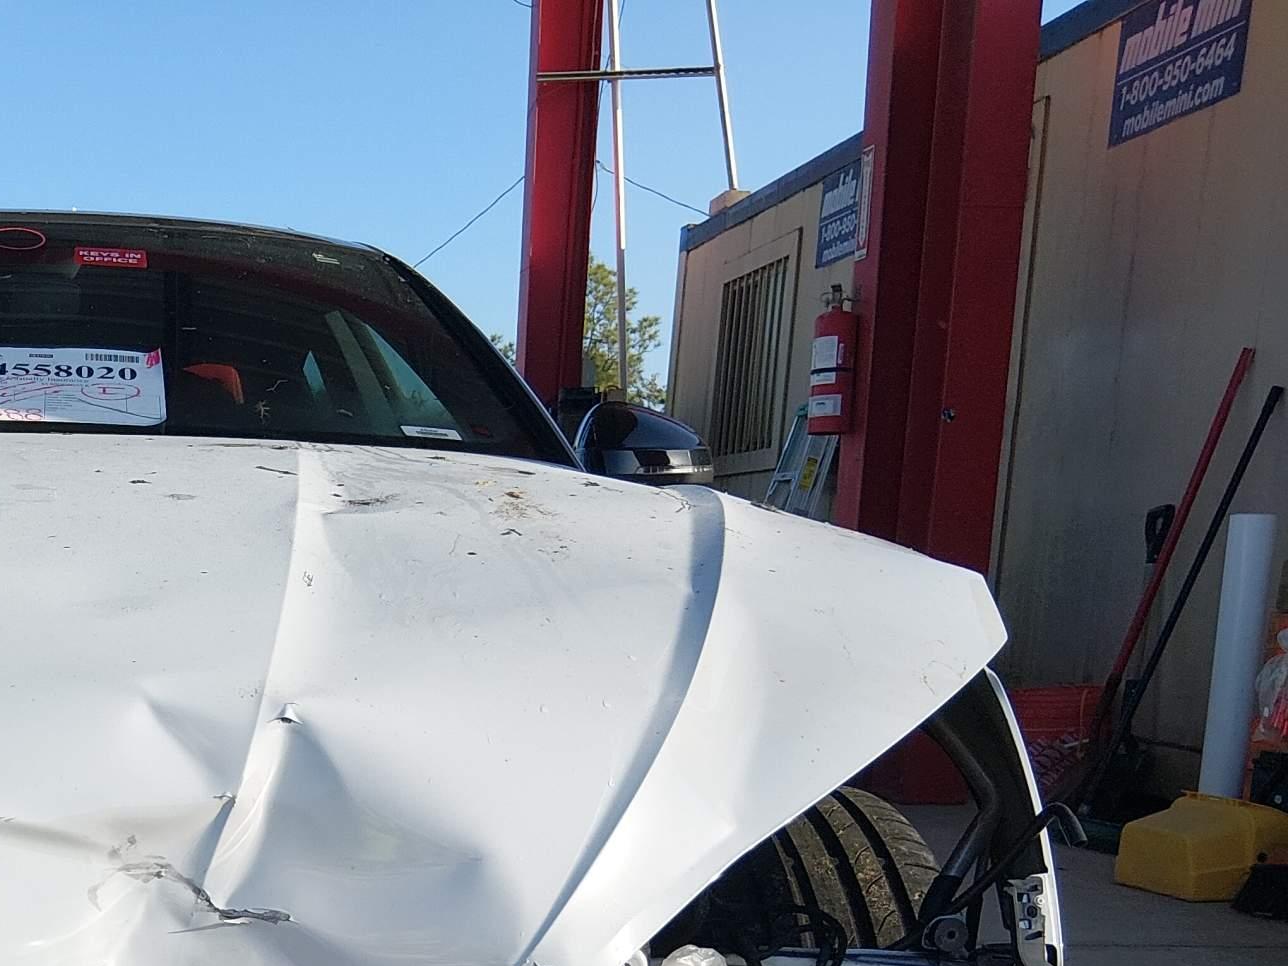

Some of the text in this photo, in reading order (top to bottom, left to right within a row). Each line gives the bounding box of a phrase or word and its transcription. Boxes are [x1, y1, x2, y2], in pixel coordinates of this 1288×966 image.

[1120, 0, 1195, 74] mobile
[1120, 32, 1238, 110] 1-800-950-6464
[1122, 77, 1225, 137] mobilemini.com
[79, 250, 121, 258] KEYS
[83, 256, 138, 264] OFFICE
